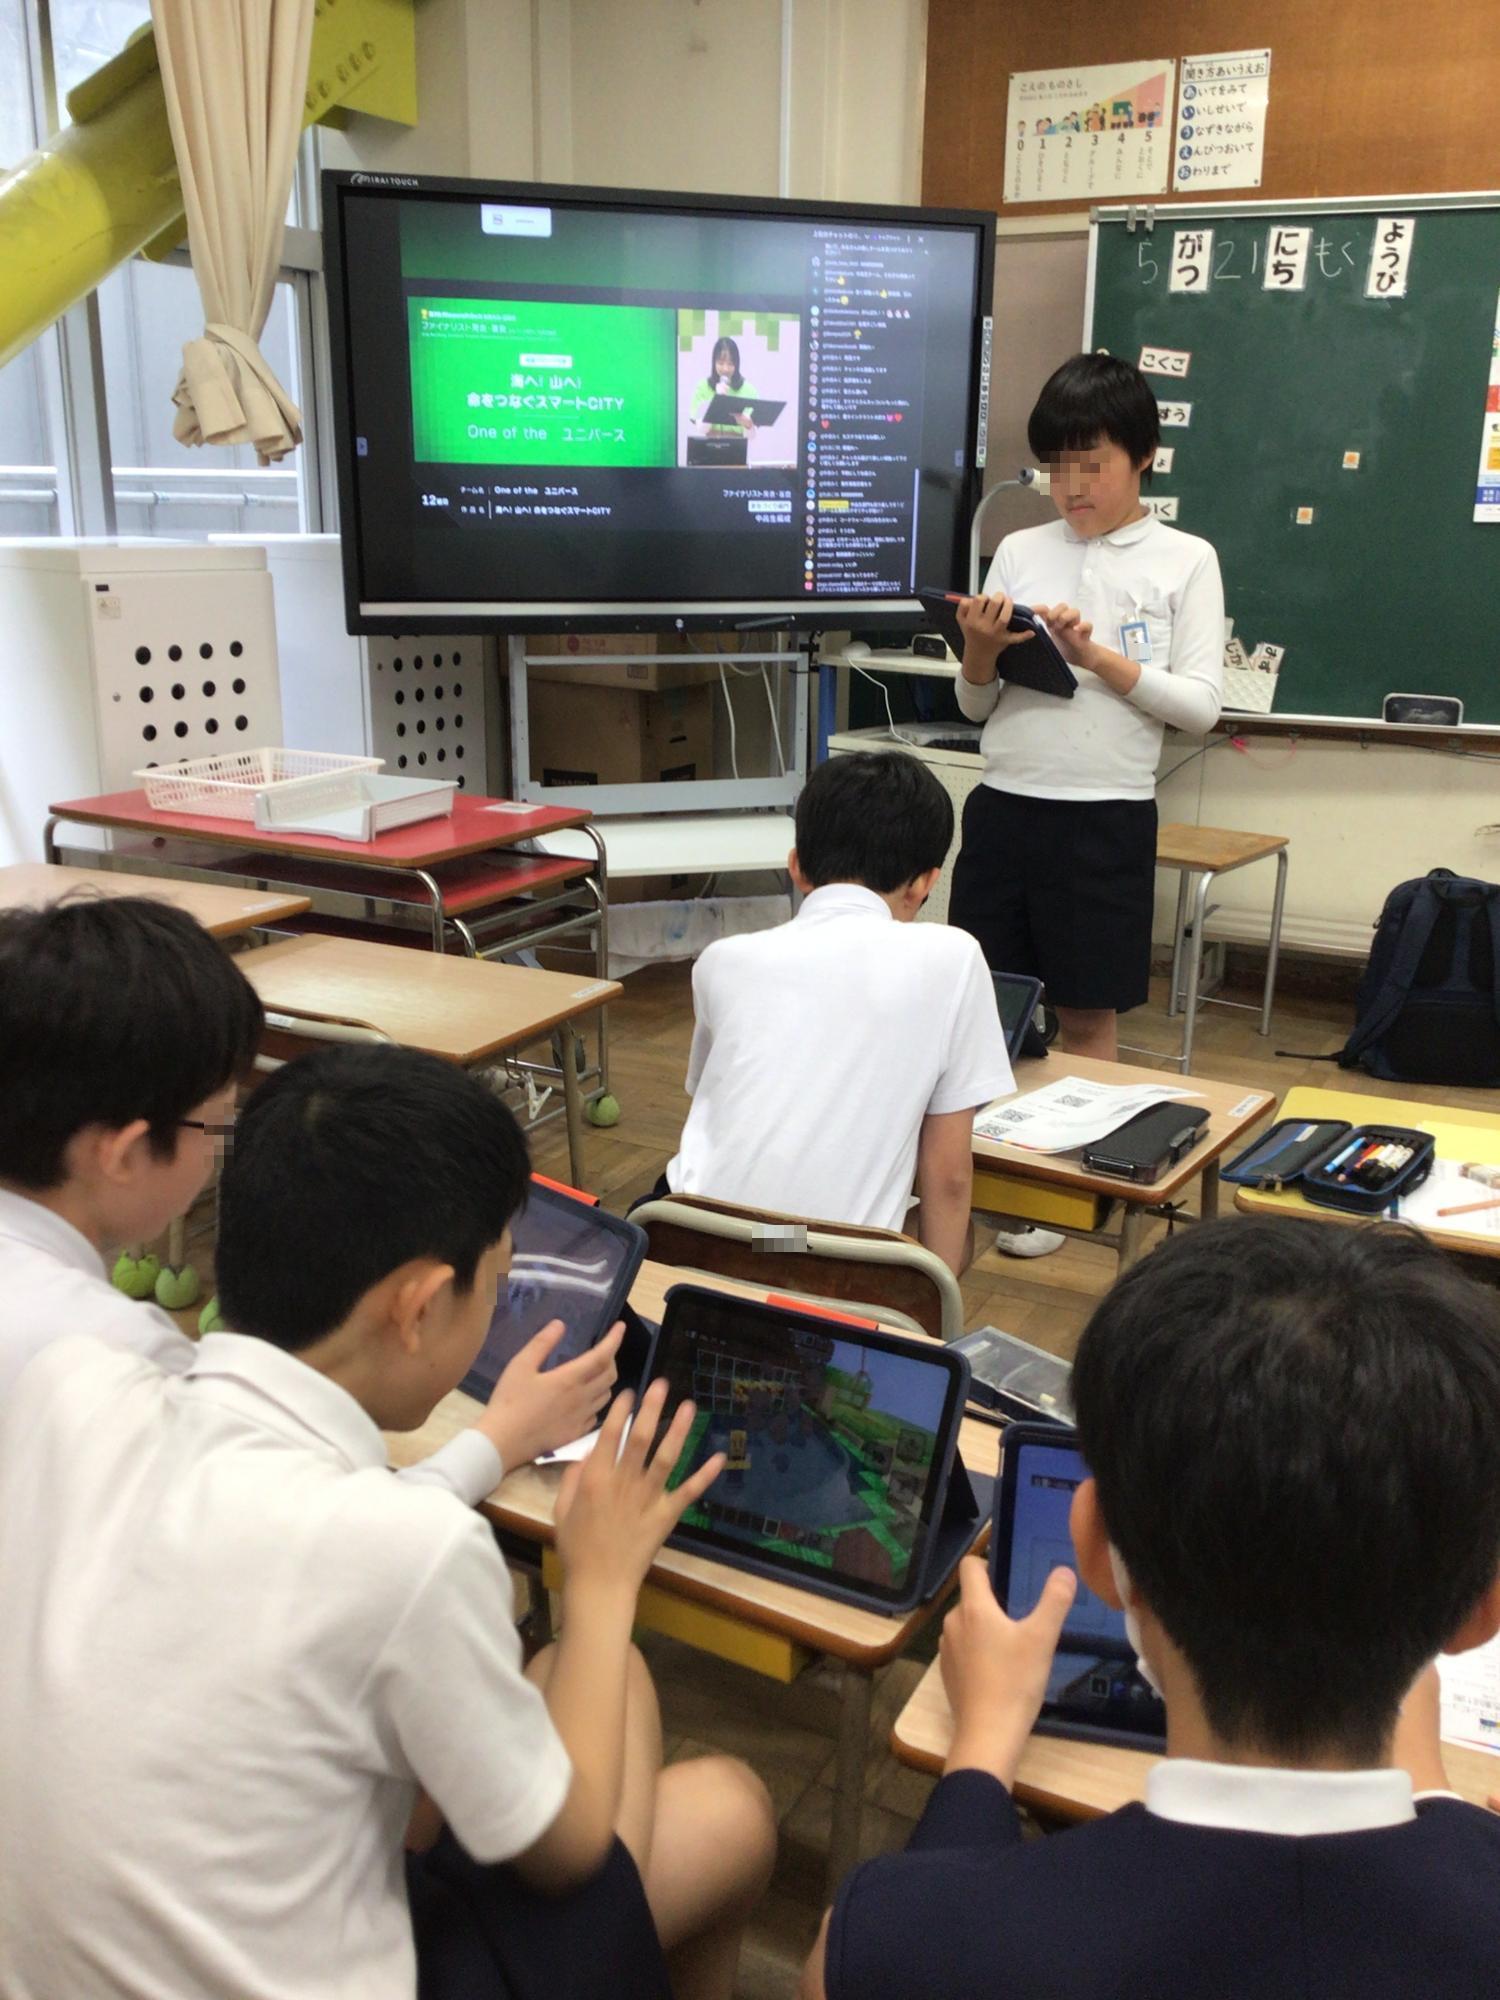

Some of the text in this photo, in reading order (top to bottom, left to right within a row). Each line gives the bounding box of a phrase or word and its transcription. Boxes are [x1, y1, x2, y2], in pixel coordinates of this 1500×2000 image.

[1017, 131, 1152, 150] 0 1 2 3 4 5
[1138, 222, 1405, 292] 5 がつ 21 にち もく ようび
[1143, 353, 1186, 372] こくご
[1159, 408, 1186, 422] すう
[467, 424, 625, 442] One of the ユニバース
[494, 486, 511, 494] One
[513, 486, 522, 494] of
[524, 486, 538, 495] the
